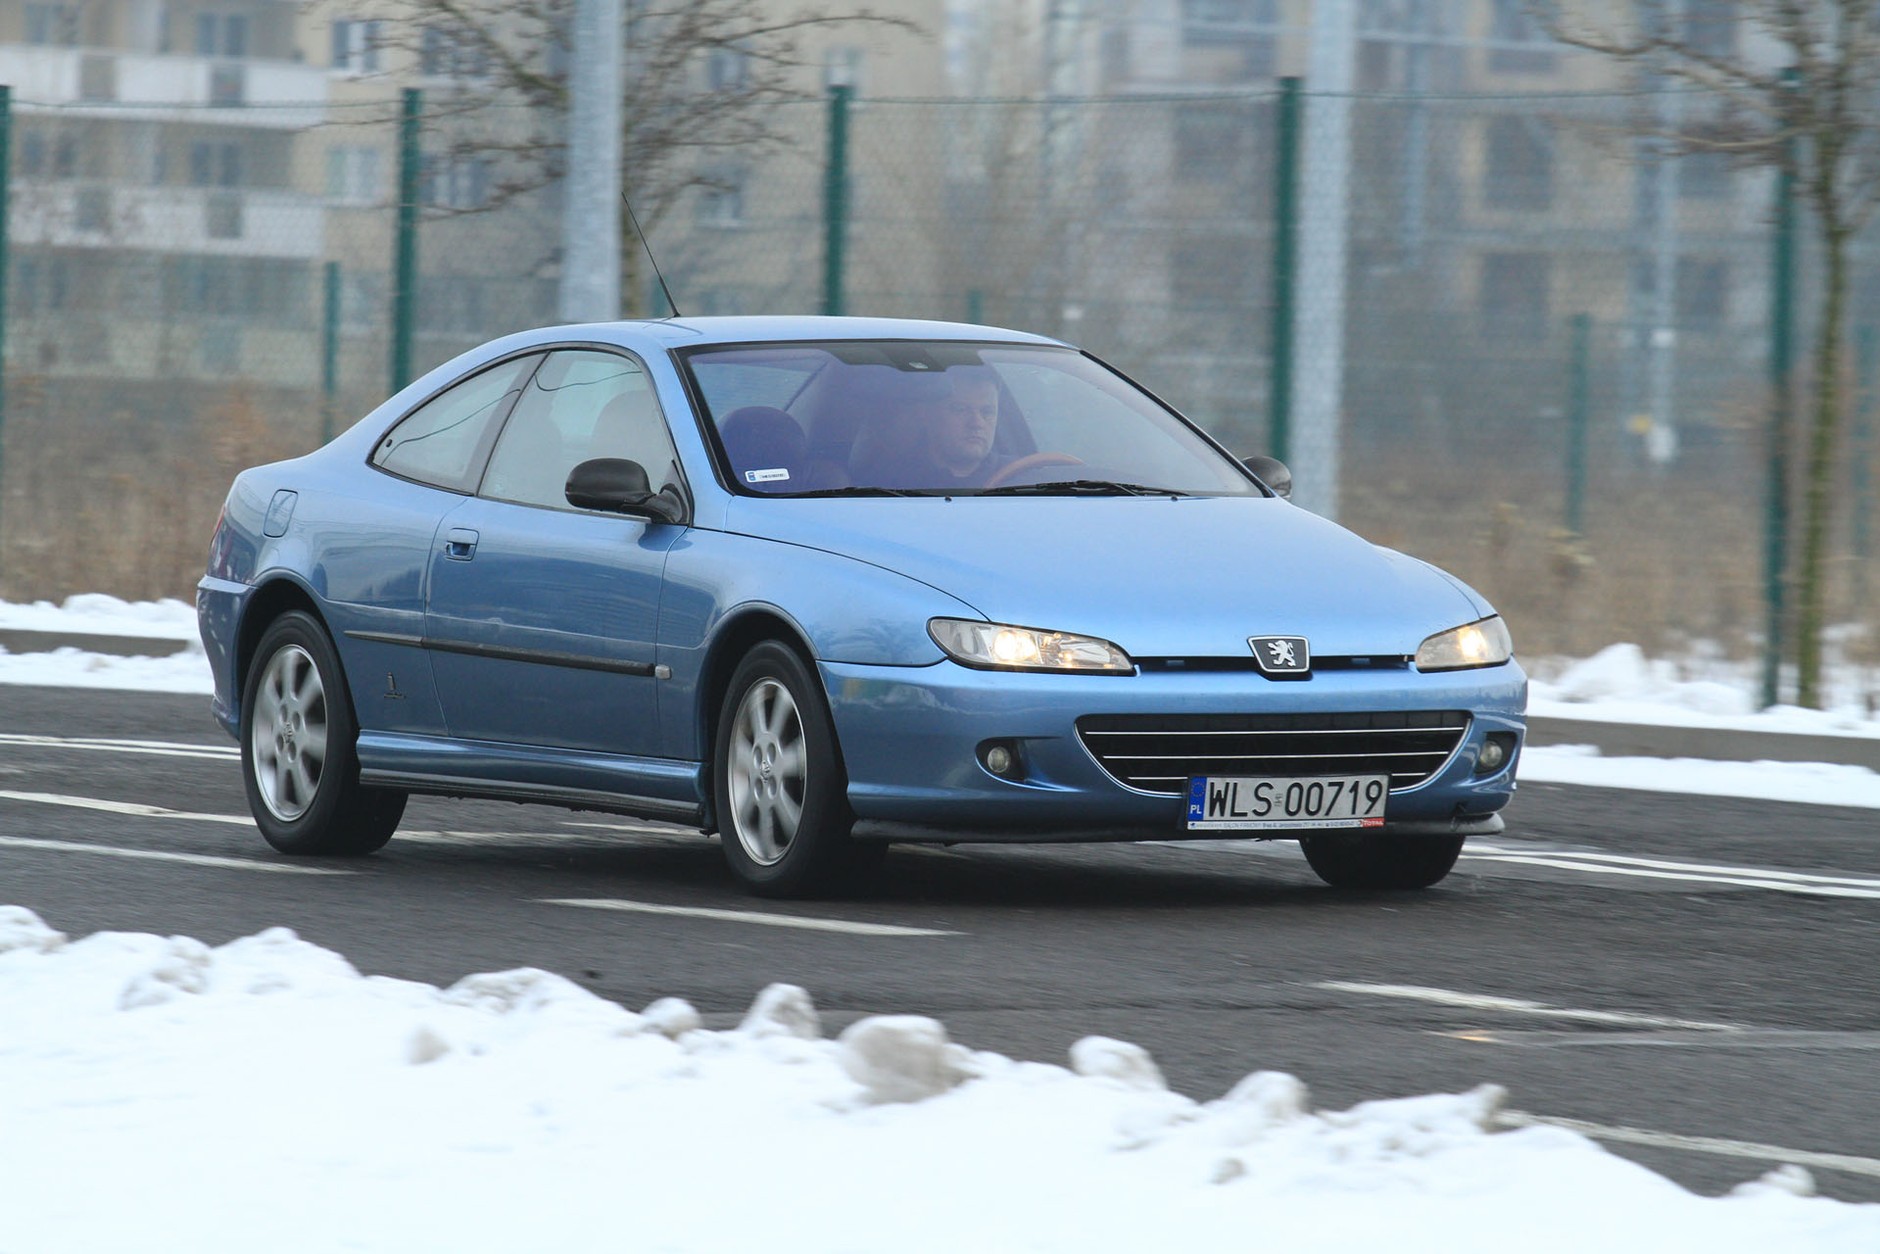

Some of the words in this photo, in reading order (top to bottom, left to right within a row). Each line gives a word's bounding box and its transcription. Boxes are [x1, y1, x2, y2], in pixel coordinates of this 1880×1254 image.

[1190, 804, 1202, 815] PL
[1208, 782, 1274, 817] WLS
[1284, 780, 1383, 817] 00719
